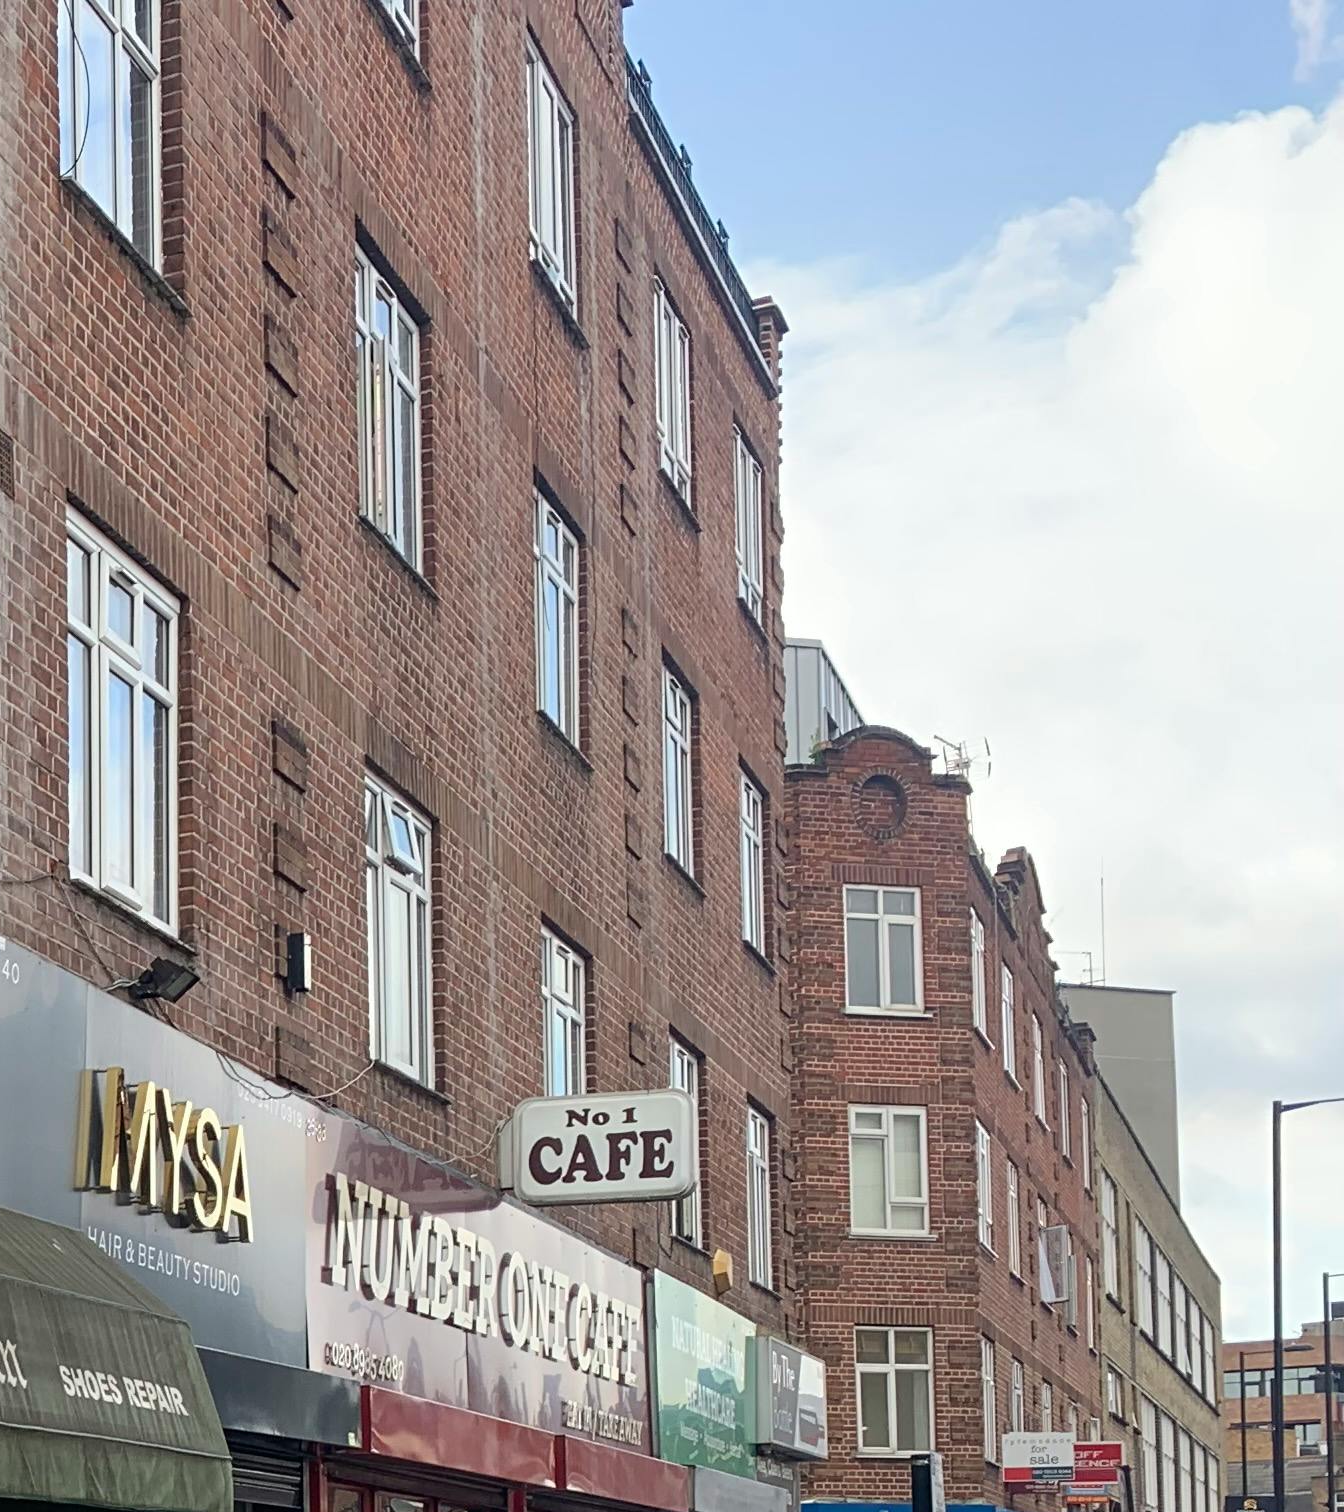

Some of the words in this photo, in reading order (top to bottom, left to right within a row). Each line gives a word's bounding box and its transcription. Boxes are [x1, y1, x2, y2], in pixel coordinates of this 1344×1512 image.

[2, 959, 20, 985] 40
[565, 1108, 610, 1127] No
[622, 1107, 638, 1124] 1
[74, 1066, 254, 1243] MYSA
[529, 1128, 675, 1187] CAFE
[87, 1226, 121, 1257] HAIR
[125, 1239, 136, 1263] &
[137, 1244, 191, 1281] BEAUTY
[192, 1262, 240, 1297] STUDIO
[327, 1172, 498, 1339] NUMBER
[506, 1251, 570, 1363] ONE
[575, 1282, 641, 1387] CAFE
[57, 1364, 120, 1405] SHOES
[122, 1377, 190, 1416] REPAIR
[772, 1350, 781, 1394] By
[781, 1354, 796, 1392] The
[1029, 1454, 1059, 1465] sale
[1031, 1445, 1047, 1453] for
